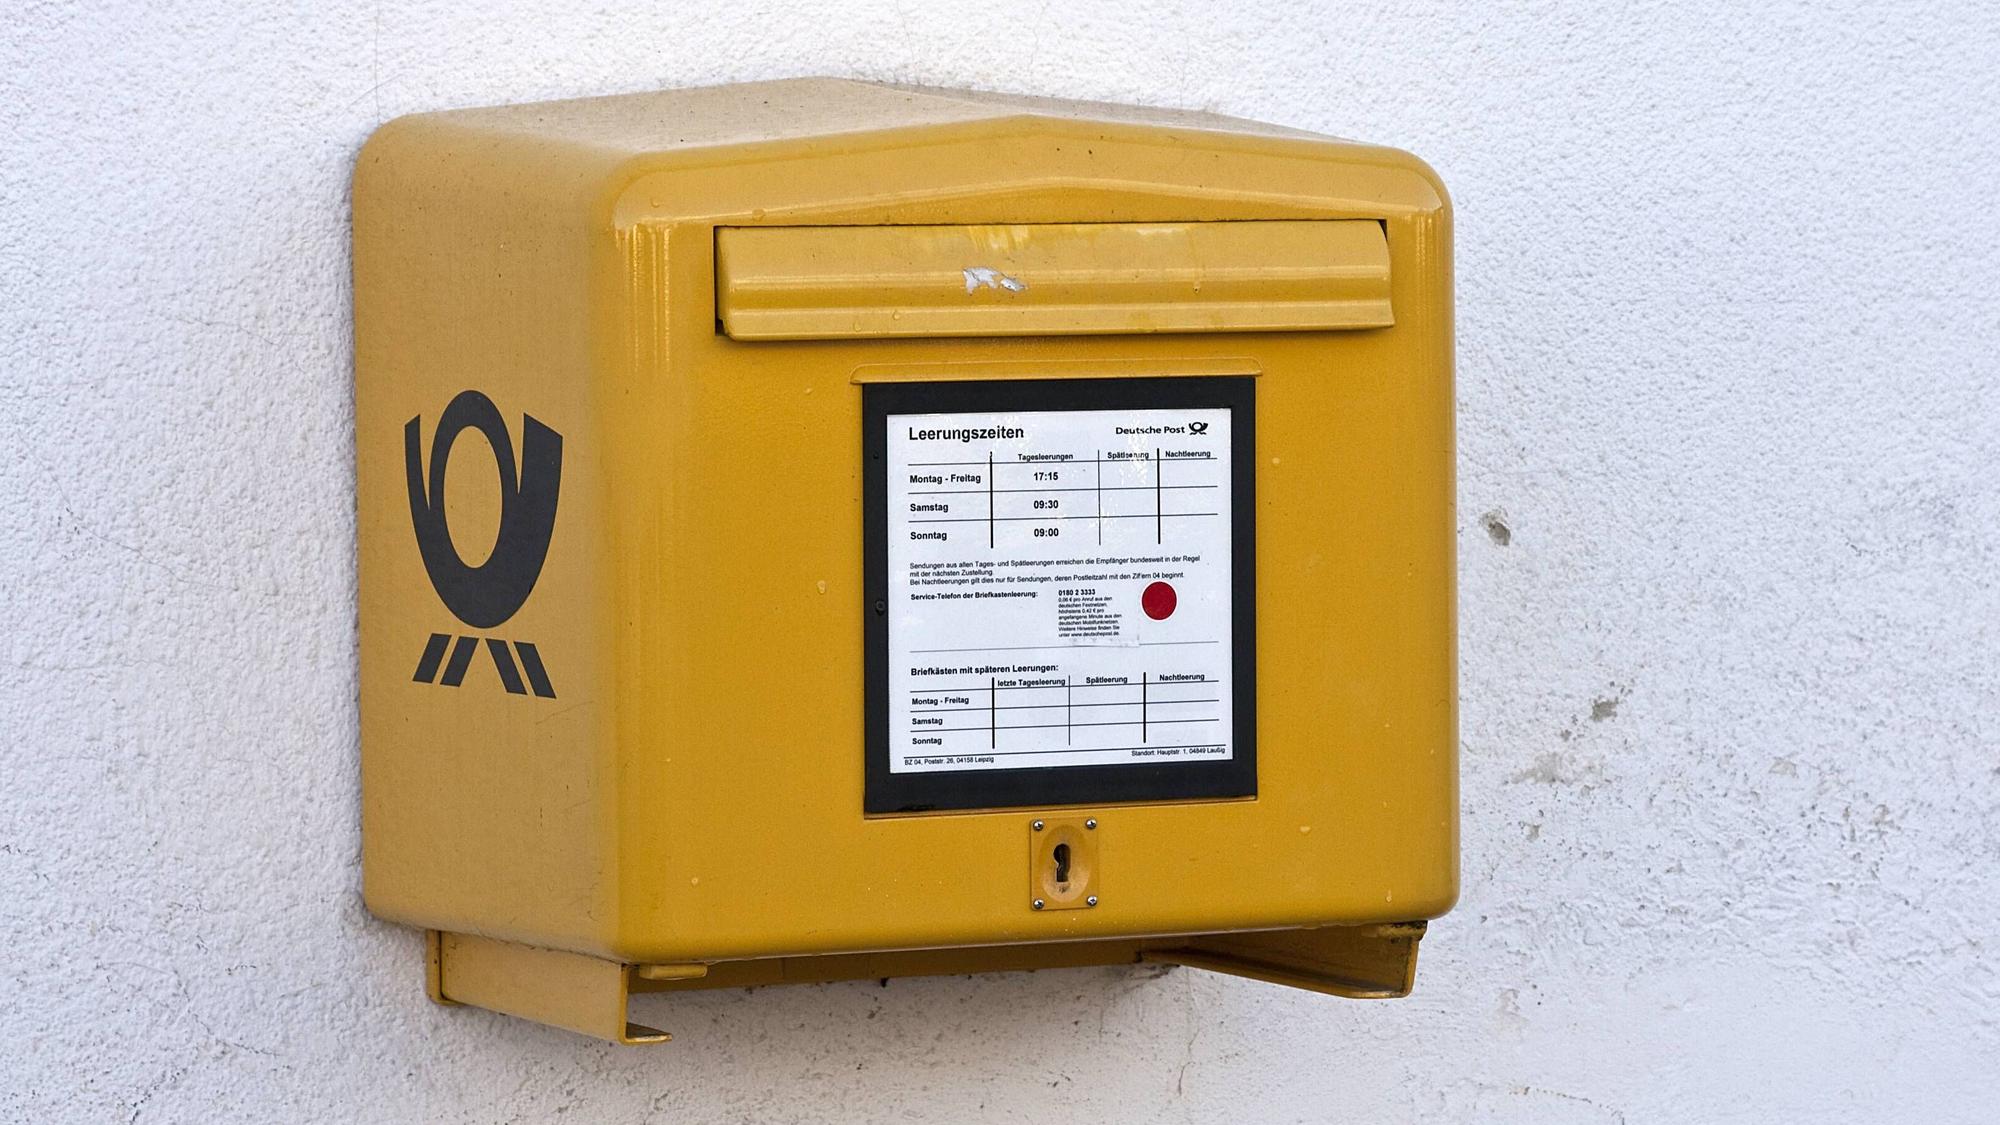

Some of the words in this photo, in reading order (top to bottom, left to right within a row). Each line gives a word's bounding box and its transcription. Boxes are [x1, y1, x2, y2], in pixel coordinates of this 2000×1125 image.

[909, 426, 1024, 442] Leerungszeiten
[1116, 426, 1162, 434] Deutsche
[1164, 426, 1185, 434] Post
[1018, 453, 1074, 462] Tagesleerungen
[1166, 450, 1211, 459] Nachtleerung
[910, 475, 943, 484] Montag
[950, 474, 981, 484] Freitag
[1034, 472, 1058, 481] 17:15
[910, 503, 949, 513] Samstag
[1034, 500, 1059, 509] 09:30
[910, 532, 947, 541] Sonntag
[1034, 528, 1059, 537] 09:00
[911, 667, 957, 676] Briefkästen
[975, 665, 1010, 675] späteren
[1012, 664, 1059, 674] Leerungen:
[1018, 678, 1066, 687] Tagesleerung
[1086, 676, 1128, 686] Spätleerung
[1159, 674, 1205, 682] Nachtleerung
